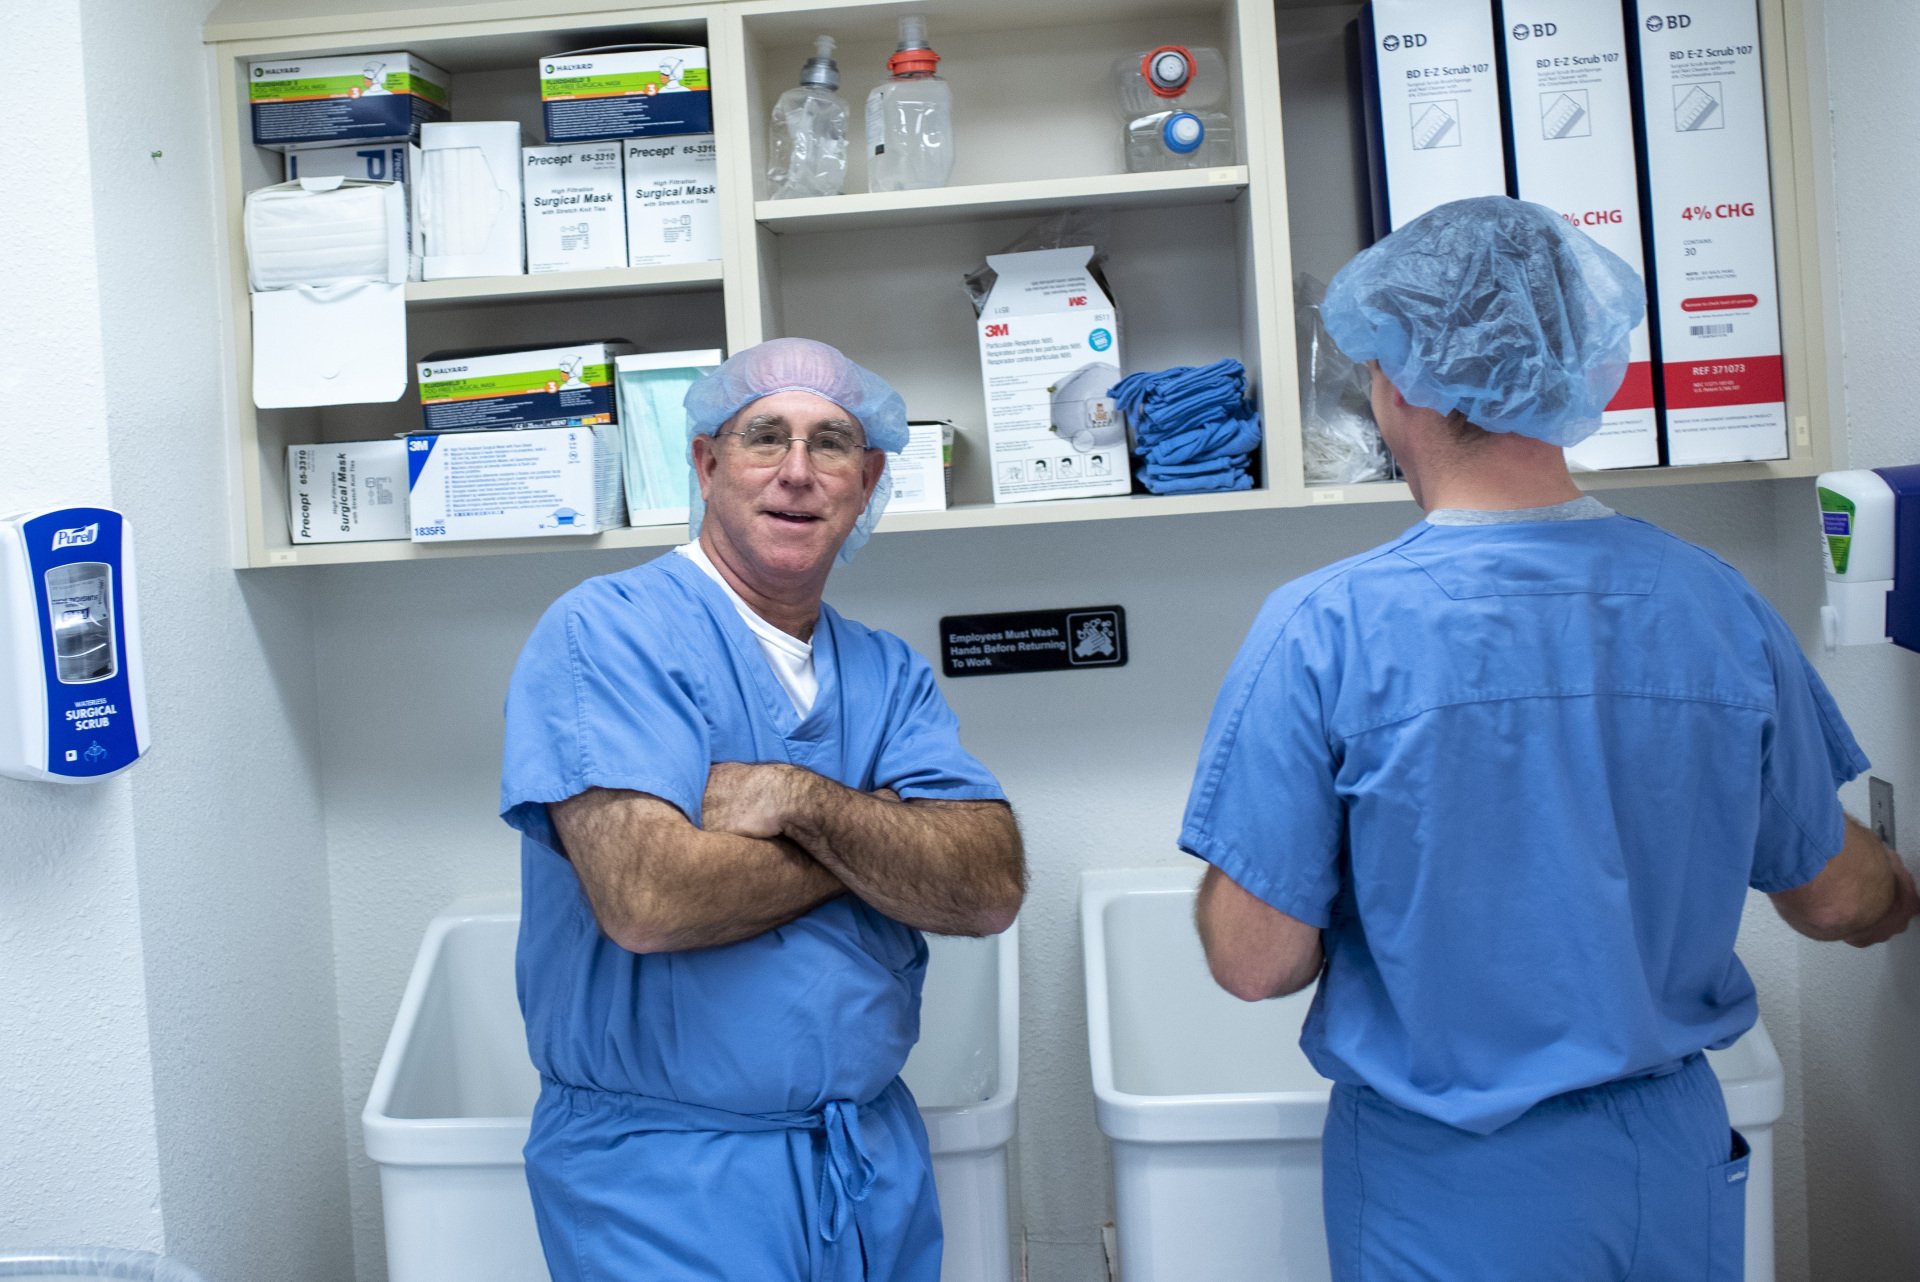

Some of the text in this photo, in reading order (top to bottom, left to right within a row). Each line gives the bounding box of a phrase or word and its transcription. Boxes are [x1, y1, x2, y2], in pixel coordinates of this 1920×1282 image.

[1666, 14, 1691, 29] BD
[1533, 23, 1557, 37] BD
[1403, 33, 1427, 48] BD
[1669, 45, 1753, 60] BD E-Z Scrub 107
[556, 63, 593, 72] HALYARD
[1536, 53, 1619, 68] BD E-Z Scrub 107
[1406, 63, 1489, 79] BD E-Z Scrub 107
[352, 87, 360, 98] 3
[648, 84, 656, 96] 3
[628, 146, 675, 158] Precept
[528, 153, 615, 166] Precept 65-3310
[635, 184, 716, 199] Surgical Mask
[534, 193, 613, 207] Surgical Mask
[1583, 209, 1623, 226] CHG
[1681, 202, 1755, 222] 4% CHG
[1684, 247, 1697, 257] 30
[1068, 296, 1087, 307] 3M
[985, 324, 1009, 337] 3M
[433, 366, 468, 376] HALYARD
[1692, 364, 1745, 375] REF 371073
[548, 381, 556, 393] 3
[409, 440, 428, 451] 3M
[299, 450, 312, 538] Precept 65-3310
[337, 453, 351, 532] Surgical Mask
[58, 529, 94, 545] Purell
[414, 526, 446, 537] 1835FS
[949, 627, 1059, 644] Employees Must Wash
[950, 640, 1066, 656] Hands Before Returning
[952, 657, 992, 668] To Work
[65, 704, 117, 720] SURGICAL
[75, 717, 110, 731] SCRUB
